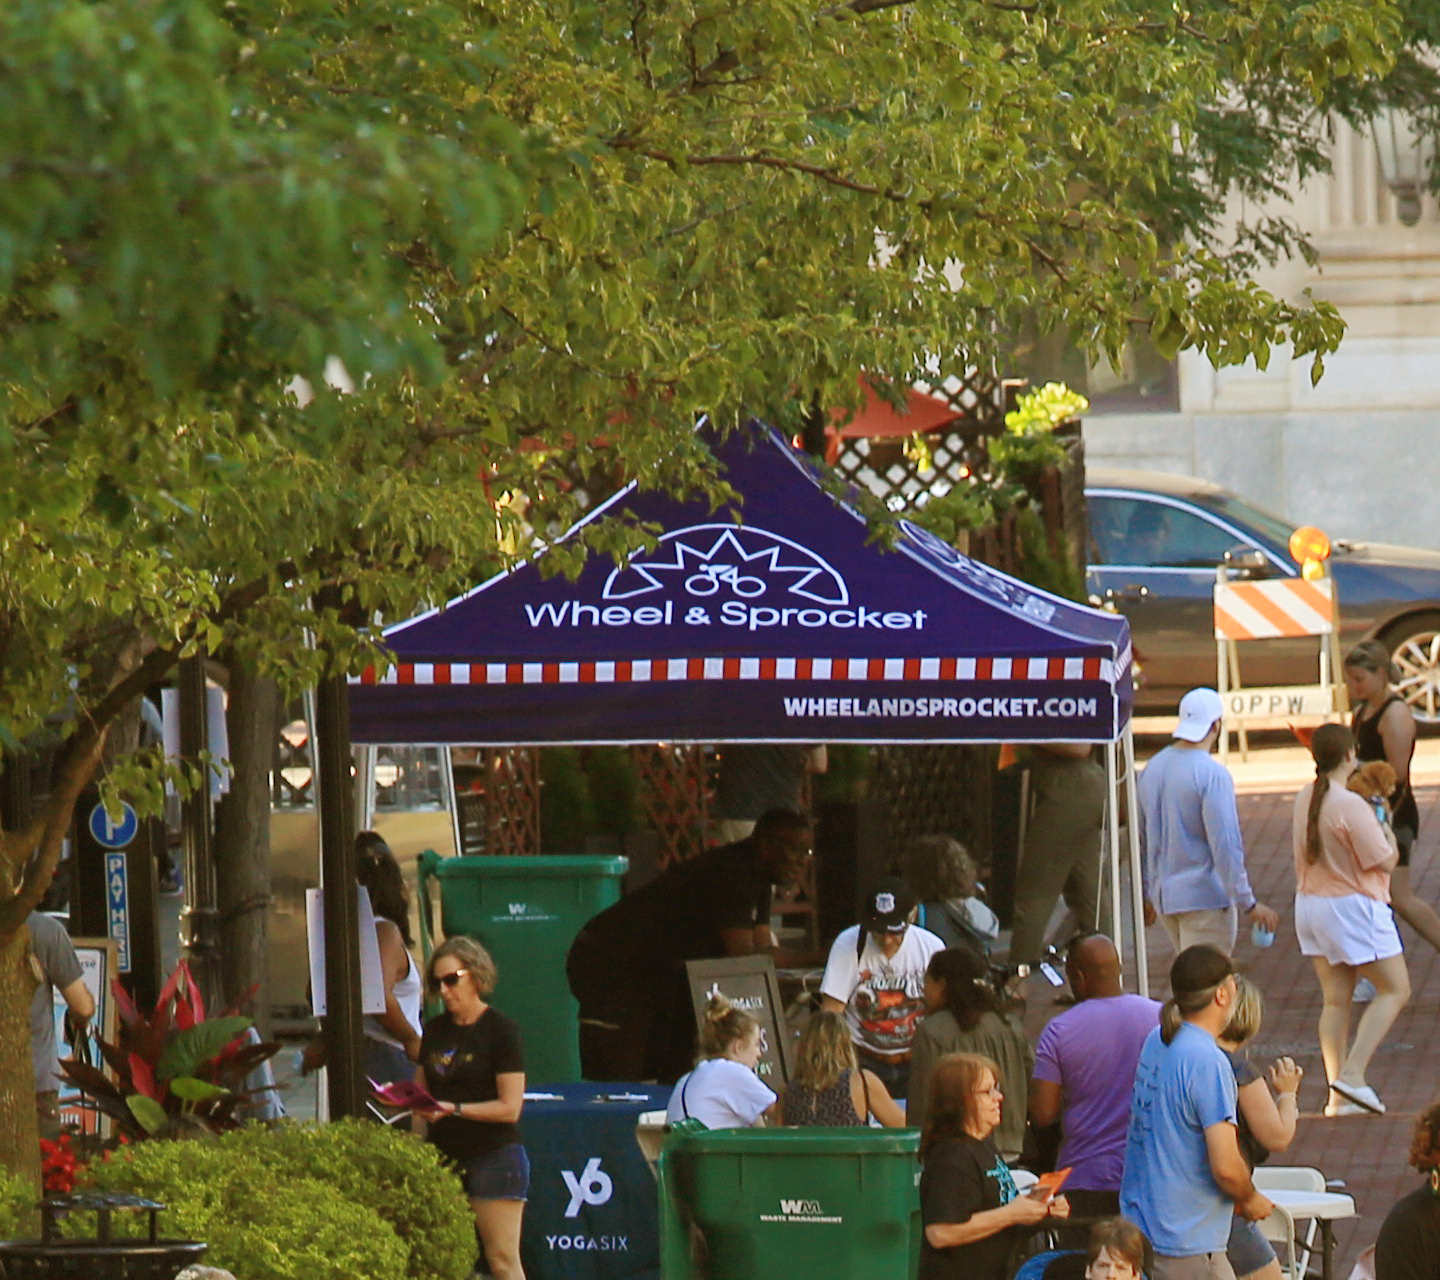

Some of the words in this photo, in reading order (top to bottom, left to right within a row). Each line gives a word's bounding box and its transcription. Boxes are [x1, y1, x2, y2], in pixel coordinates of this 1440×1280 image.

[524, 600, 672, 626] Wheel
[685, 607, 711, 626] &
[720, 600, 927, 631] Sprocket
[783, 697, 1097, 717] WHEELANDSPROCKET.COM
[1231, 695, 1304, 715] OPPW
[110, 858, 123, 903] PAY
[780, 1199, 821, 1215] WM
[760, 1214, 786, 1222] WASTE
[546, 1234, 628, 1251] YOGASIX
